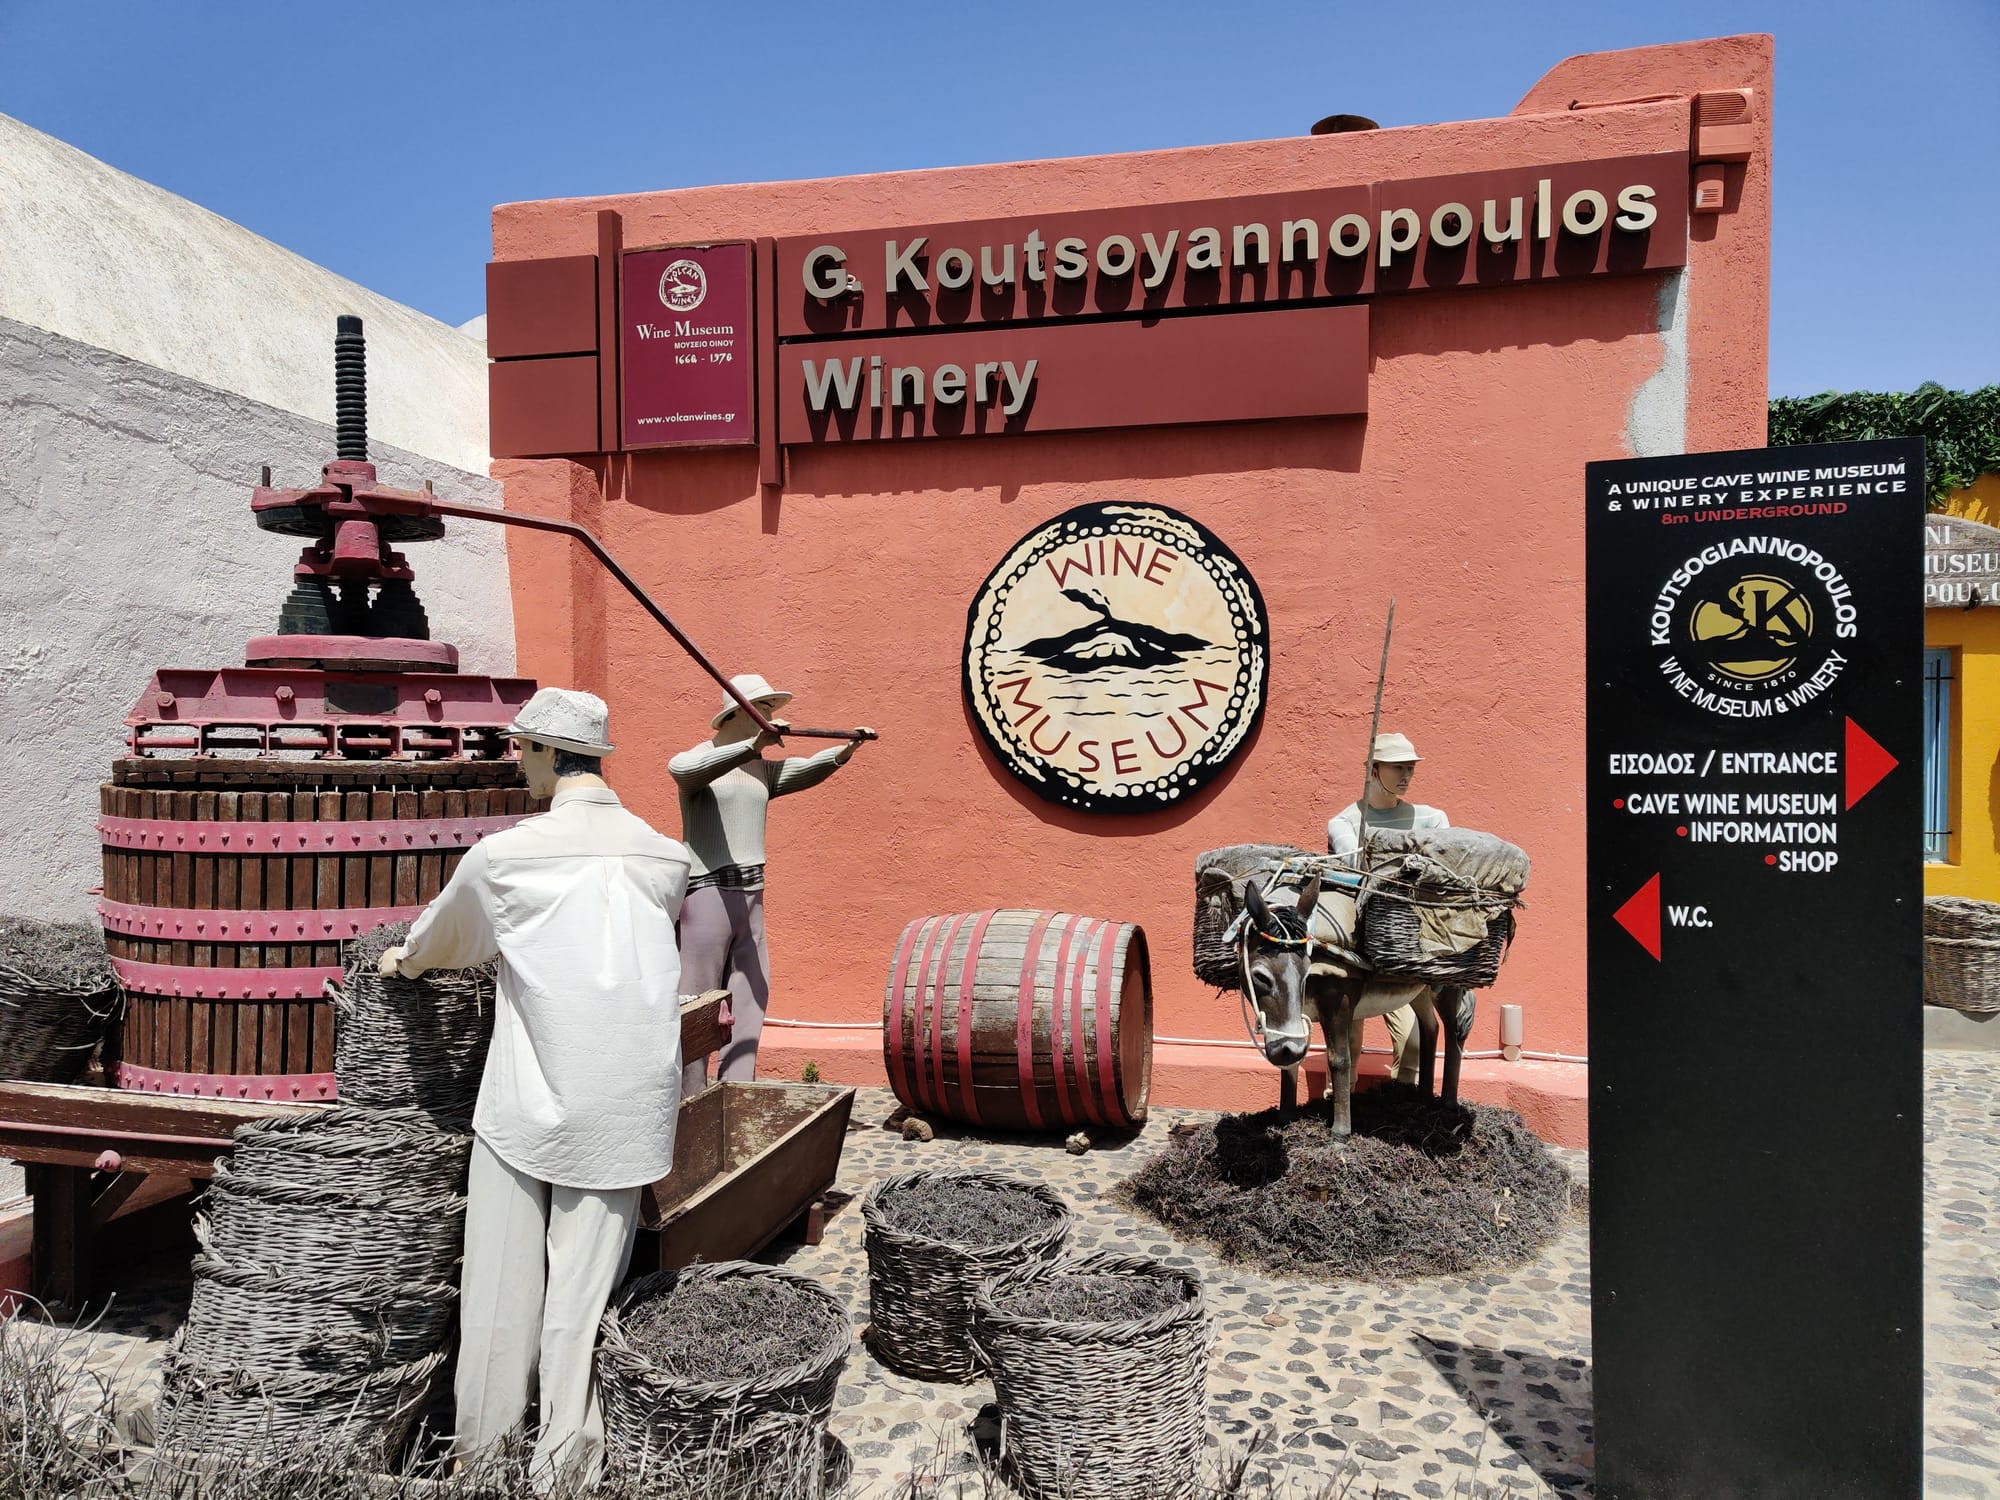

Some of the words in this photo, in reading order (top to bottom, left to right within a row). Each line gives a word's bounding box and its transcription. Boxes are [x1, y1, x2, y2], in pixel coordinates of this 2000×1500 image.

[802, 245, 861, 298] G.
[885, 178, 1658, 289] Koutsoyannopoulos
[667, 267, 699, 282] VOLCAN
[671, 294, 697, 305] WINES
[636, 324, 671, 340] Wine
[674, 321, 734, 337] Museum
[674, 341, 708, 350] ΜΟΥΣΕΙΟ
[709, 340, 734, 348] ΟΙΝΟΥ
[802, 355, 1038, 415] Winery
[637, 411, 735, 424] www.volcanwines.gr
[1608, 484, 1621, 495] A
[1625, 478, 1698, 493] UNIQUE
[1702, 474, 1753, 488] CAVE
[1757, 469, 1810, 484] WINE
[1815, 463, 1906, 480] MUSEUM
[1608, 500, 1622, 512] &
[1632, 492, 1728, 510] WINERY
[1740, 480, 1907, 503] EXPERIENCE
[1661, 513, 1689, 525] 8m
[1694, 502, 1848, 522] UNDERGROUND
[1046, 538, 1178, 588] WINE
[1651, 536, 1857, 646] KOUTSOGIANNOPOULOS
[1691, 688, 1773, 718] MUSEUM
[1774, 697, 1789, 713] &
[1785, 649, 1848, 707] WINERY
[1707, 673, 1753, 691] SINCE
[1763, 670, 1797, 689] 1870
[997, 676, 1228, 775] MUSEUM
[1609, 753, 1695, 775] ΕΙΣΟΔΟΣ
[1700, 750, 1716, 777] /
[1722, 752, 1838, 774] ENTRANCE
[1627, 794, 1679, 814] CAVE
[1685, 794, 1740, 814] WINE
[1746, 794, 1837, 815] MUSEUM
[1691, 822, 1837, 843] INFORMATION
[1779, 851, 1838, 872] SHOP
[1668, 906, 1713, 927] W.C.
